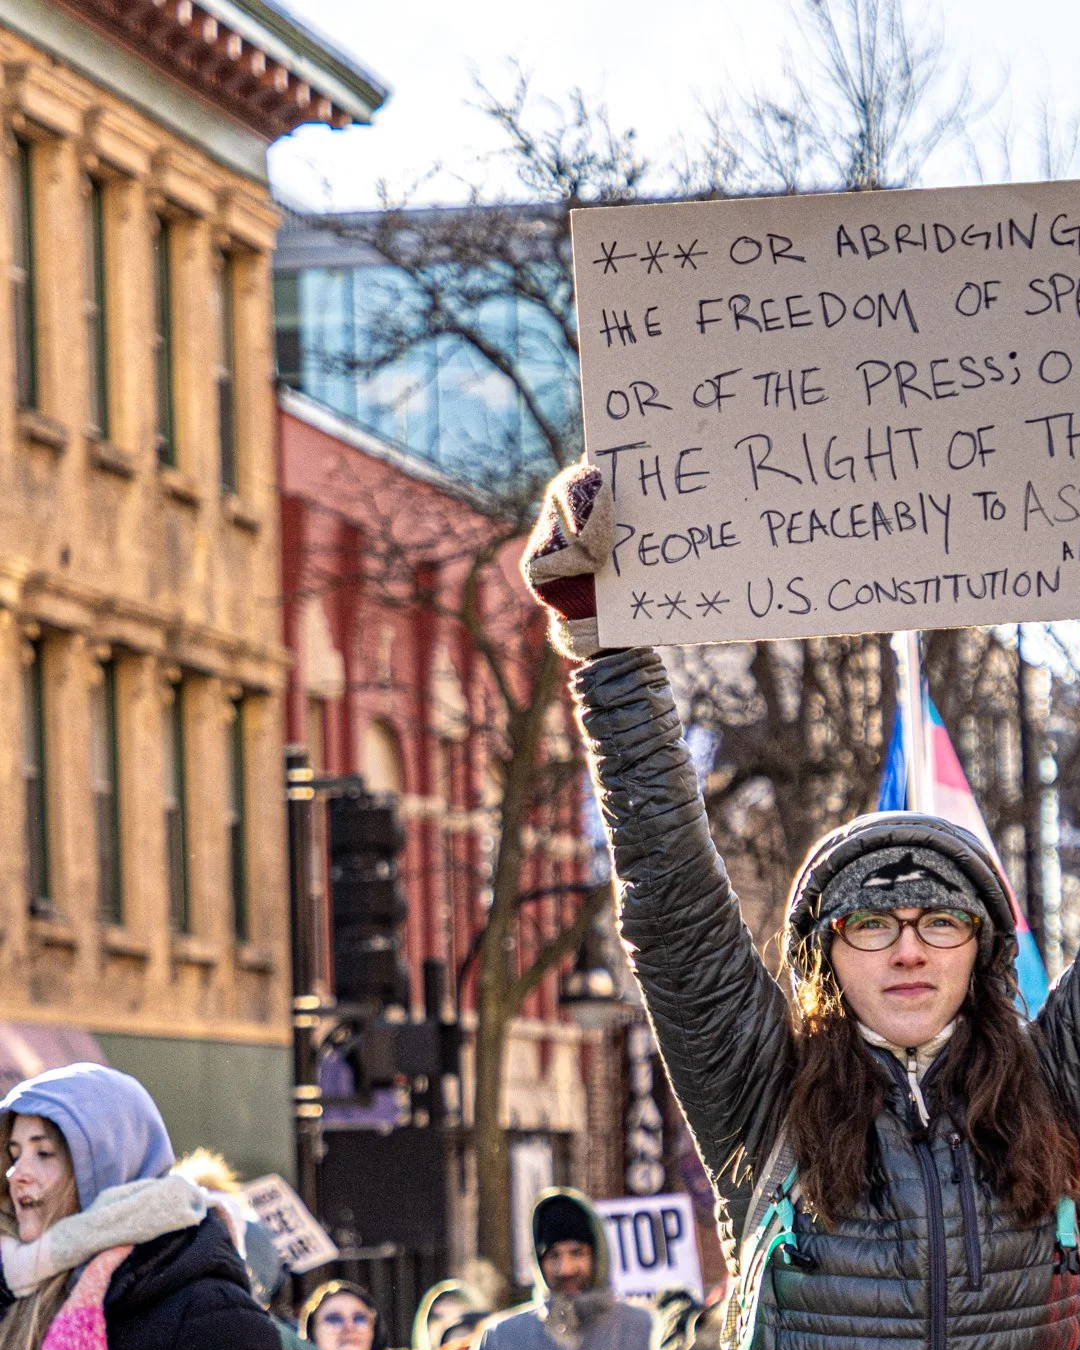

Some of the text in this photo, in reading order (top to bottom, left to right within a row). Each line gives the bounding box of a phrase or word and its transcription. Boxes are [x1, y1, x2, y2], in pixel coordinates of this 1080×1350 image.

[729, 233, 806, 265] OR
[696, 289, 920, 334] FREEDOM
[955, 280, 1001, 317] OF
[606, 381, 673, 420] OR
[693, 367, 743, 413] OF
[752, 367, 830, 411] THE
[595, 440, 710, 502] THE
[734, 425, 922, 491] RIGHT
[947, 425, 996, 470] OF
[612, 521, 741, 577] PEOPLE
[827, 566, 1060, 611] CONSTITUTION
[607, 1208, 683, 1272] TOP
